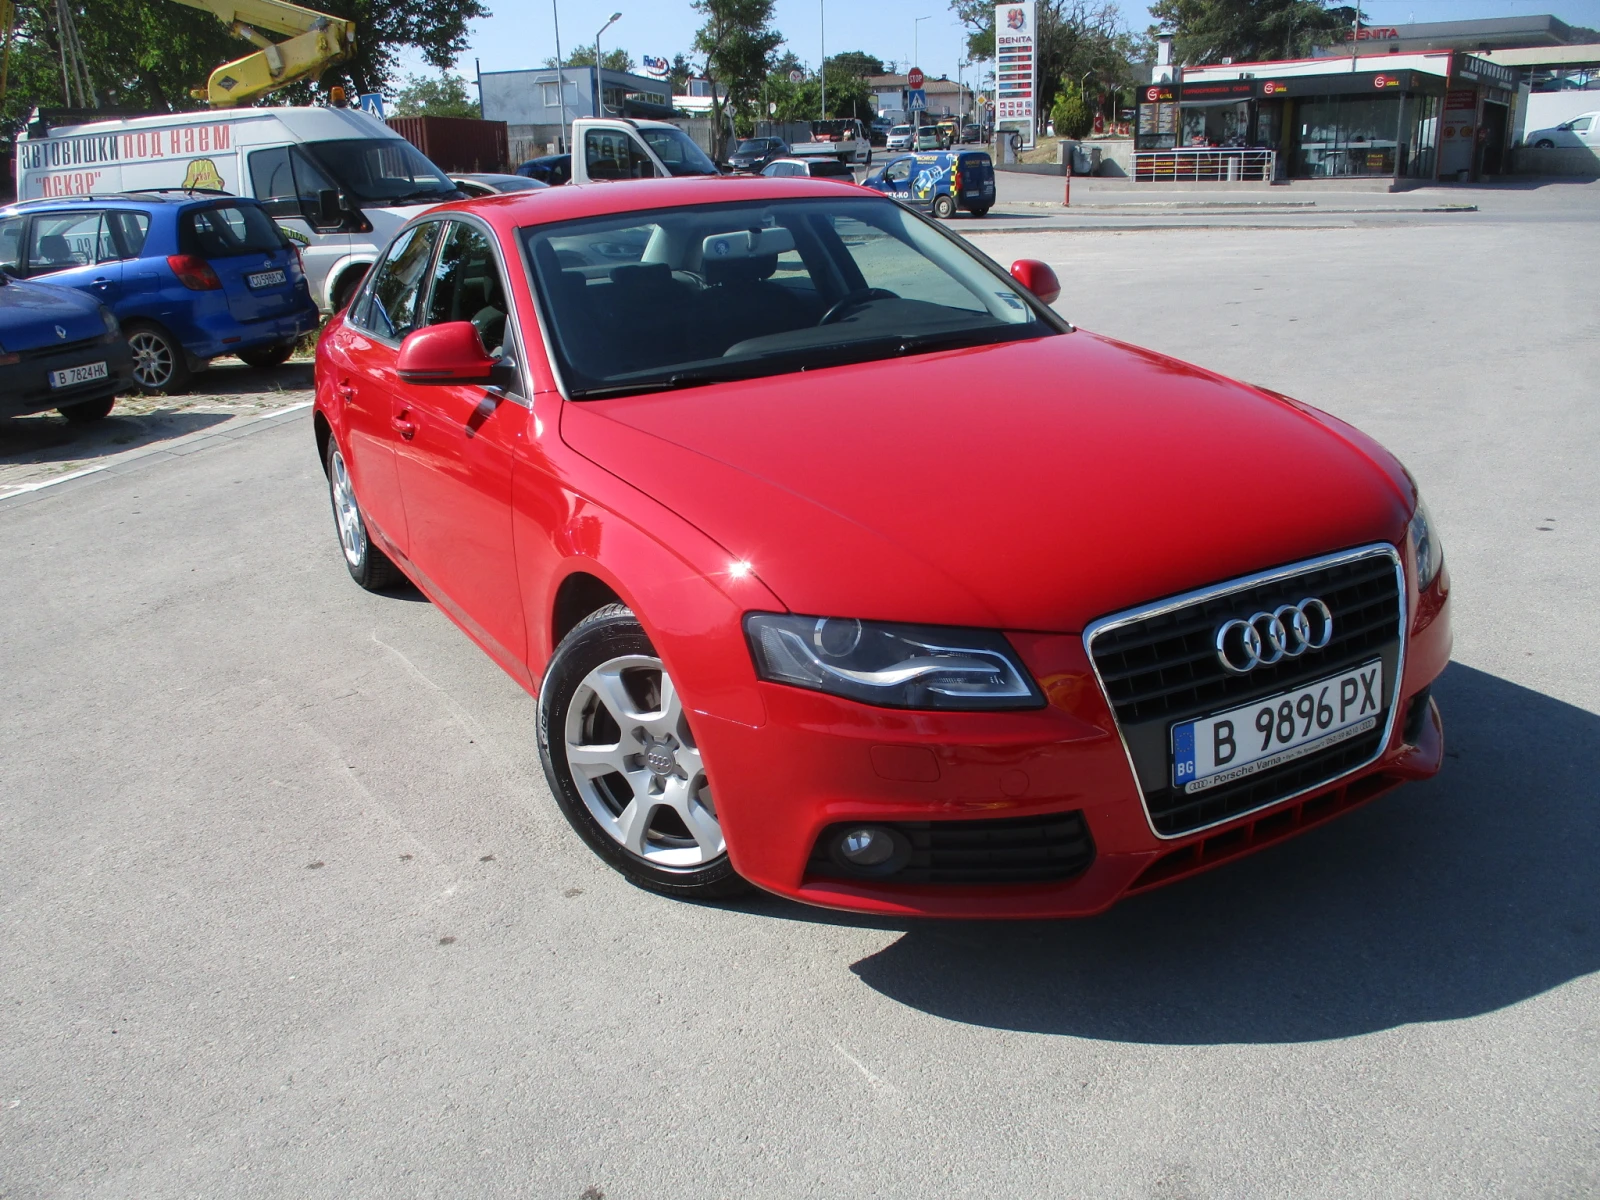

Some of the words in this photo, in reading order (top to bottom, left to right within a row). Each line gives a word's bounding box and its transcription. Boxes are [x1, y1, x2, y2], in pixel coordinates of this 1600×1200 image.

[998, 36, 1033, 44] BENITA
[909, 74, 923, 84] STOP
[59, 372, 67, 385] B
[1213, 720, 1236, 767] B
[1255, 686, 1333, 752] 9896
[1177, 760, 1194, 777] BG
[1213, 764, 1254, 785] Porsche
[1256, 756, 1281, 770] Varna
